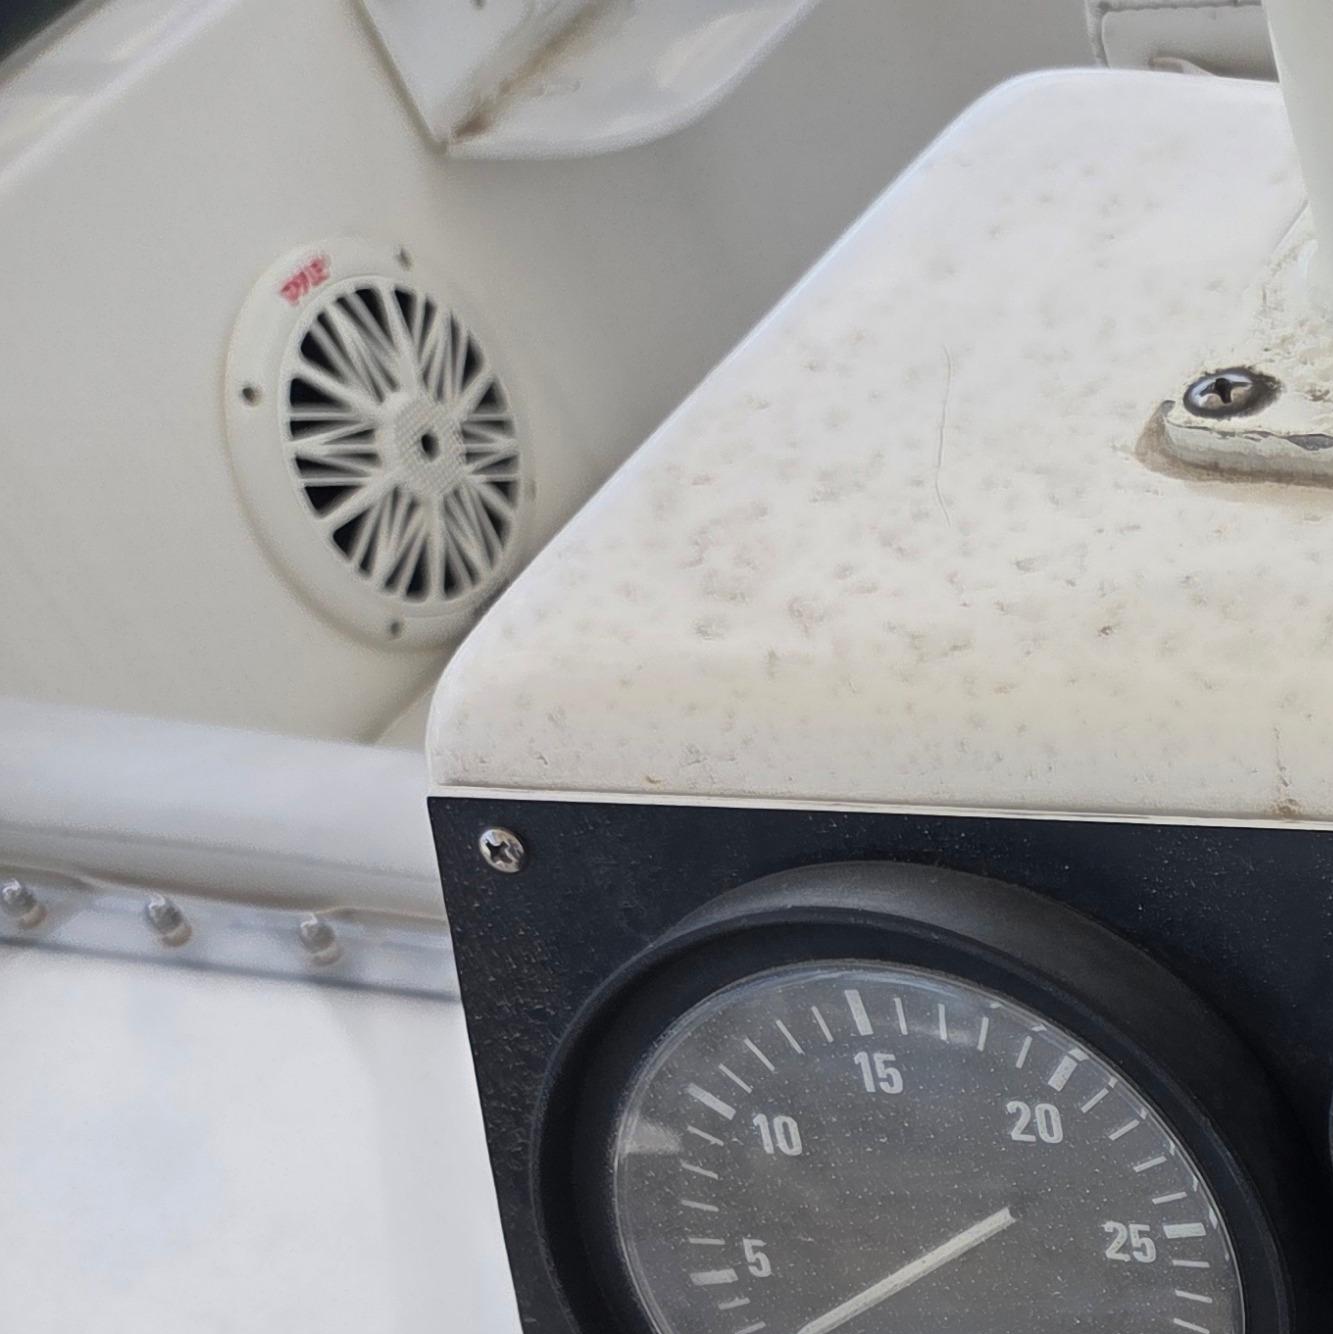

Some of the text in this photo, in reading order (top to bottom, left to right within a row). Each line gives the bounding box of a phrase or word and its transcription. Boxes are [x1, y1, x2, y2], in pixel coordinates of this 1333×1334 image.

[853, 1051, 904, 1095] 15
[752, 1112, 803, 1156] 10
[1006, 1101, 1063, 1144] 20
[743, 1237, 773, 1278] 5
[1102, 1221, 1157, 1264] 25
